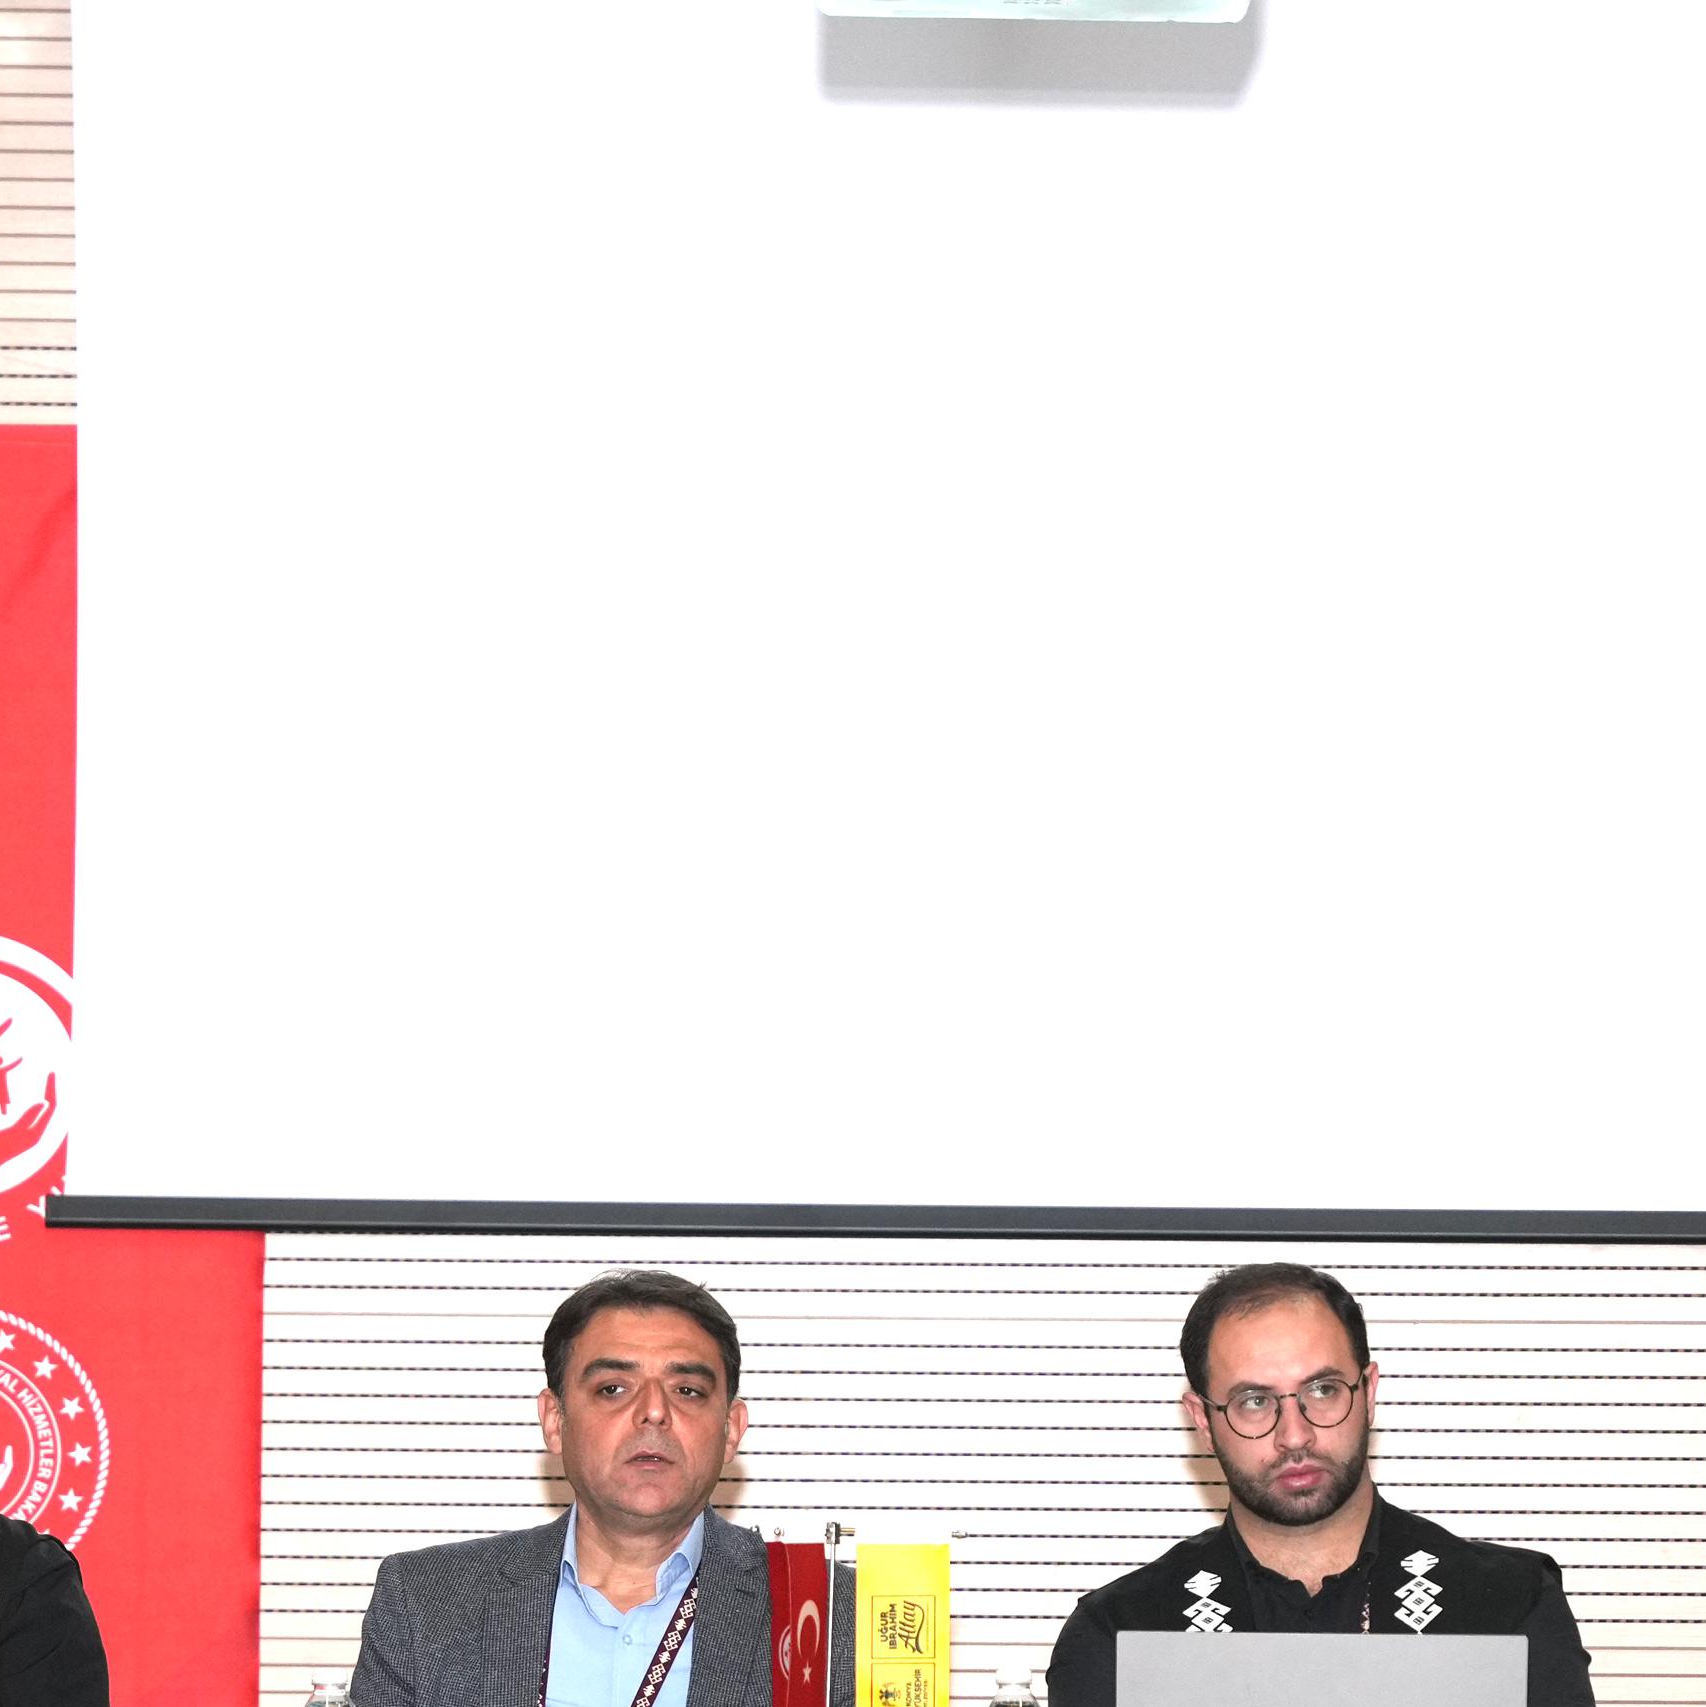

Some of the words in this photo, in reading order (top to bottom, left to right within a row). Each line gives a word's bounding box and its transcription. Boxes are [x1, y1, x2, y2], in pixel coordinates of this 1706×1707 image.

[16, 1387, 54, 1478] HİZMETLER
[878, 1612, 889, 1643] UĞUR
[898, 1600, 925, 1655] Altay
